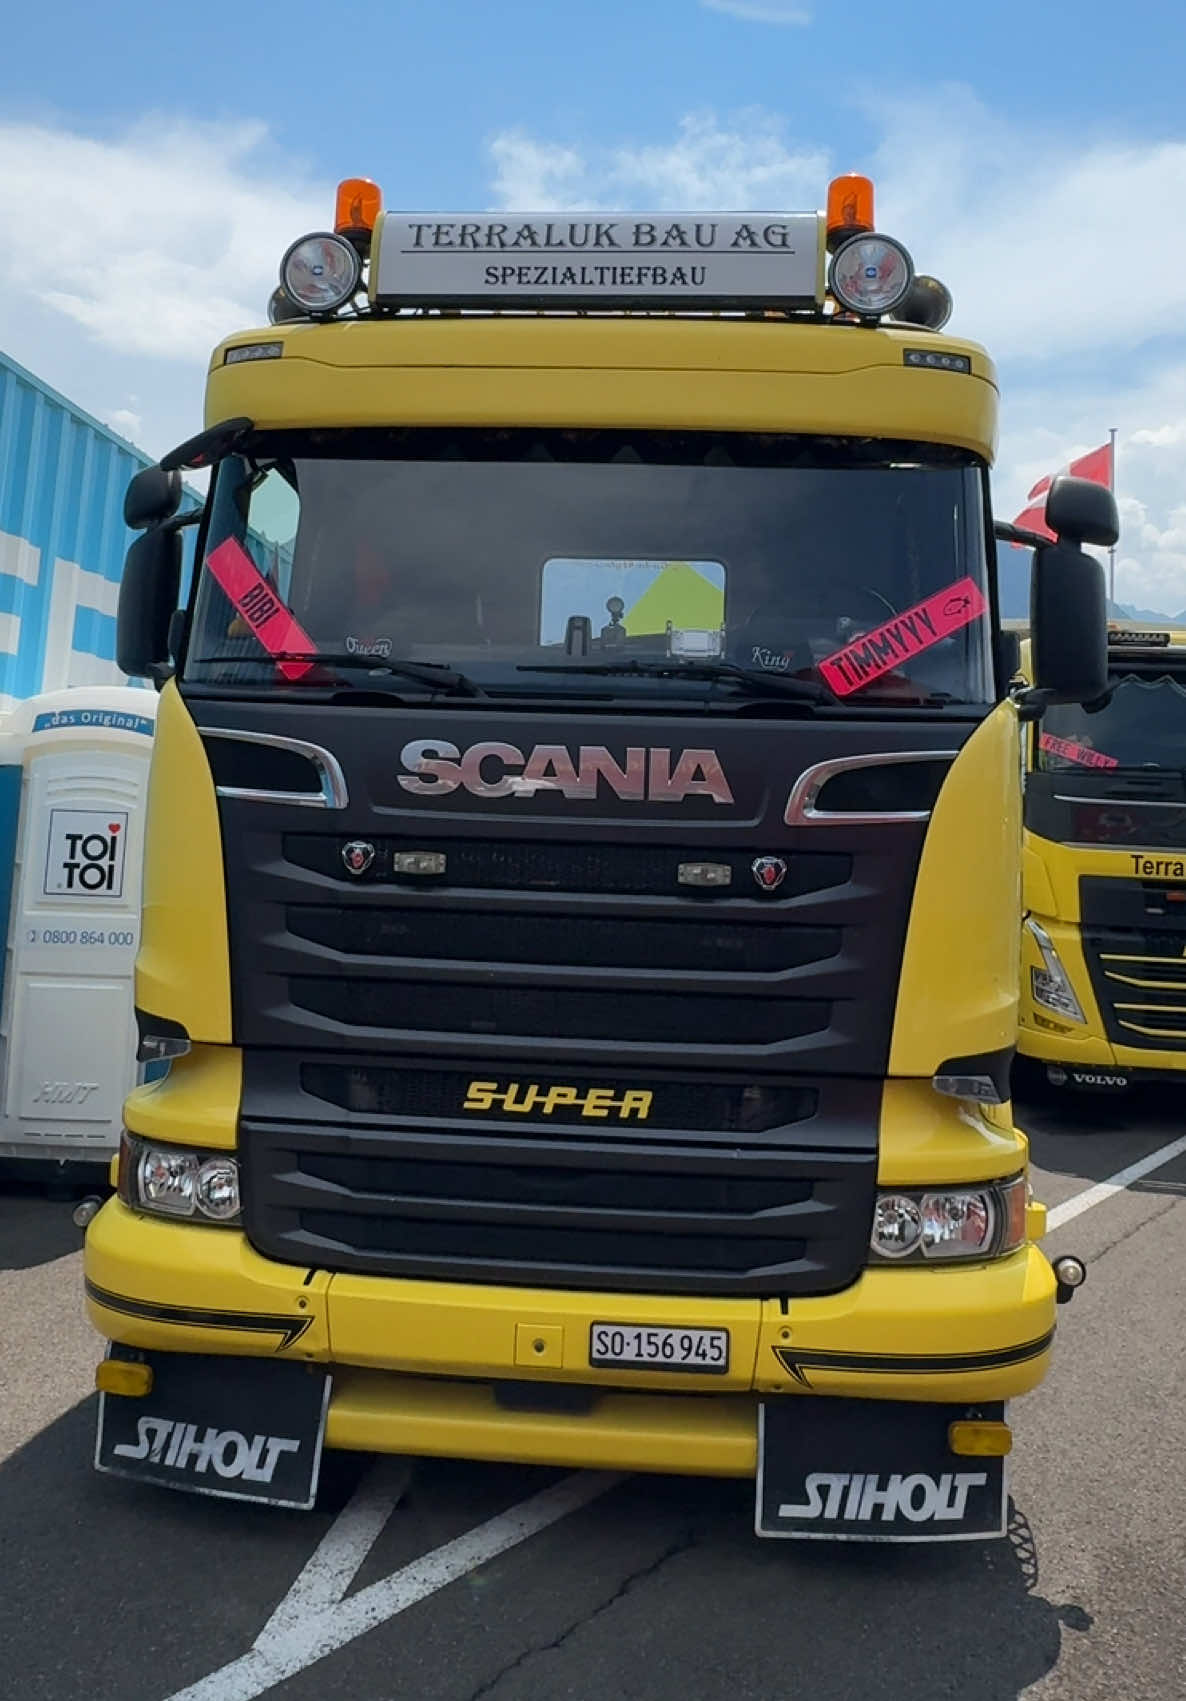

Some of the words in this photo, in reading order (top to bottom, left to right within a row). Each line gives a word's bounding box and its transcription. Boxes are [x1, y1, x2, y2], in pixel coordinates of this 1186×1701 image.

[408, 223, 622, 249] TERRALUK
[632, 223, 718, 249] BAU
[729, 223, 791, 249] AG
[484, 266, 707, 286] SPEZIALTIEFBAU
[239, 582, 280, 629] BIBI
[752, 646, 791, 672] King
[830, 607, 937, 687] TIMMYYY
[396, 739, 735, 804] SCANIA
[65, 824, 120, 861] TOI
[63, 863, 115, 890] TOI
[1130, 854, 1185, 877] Terra
[43, 929, 77, 944] 0800
[80, 930, 104, 945] 864
[108, 931, 134, 945] 000
[1072, 1073, 1127, 1086] VOLVO
[463, 1081, 653, 1119] SUPER
[113, 1416, 300, 1482] STIHOLT
[778, 1472, 987, 1522] STIHOLT
